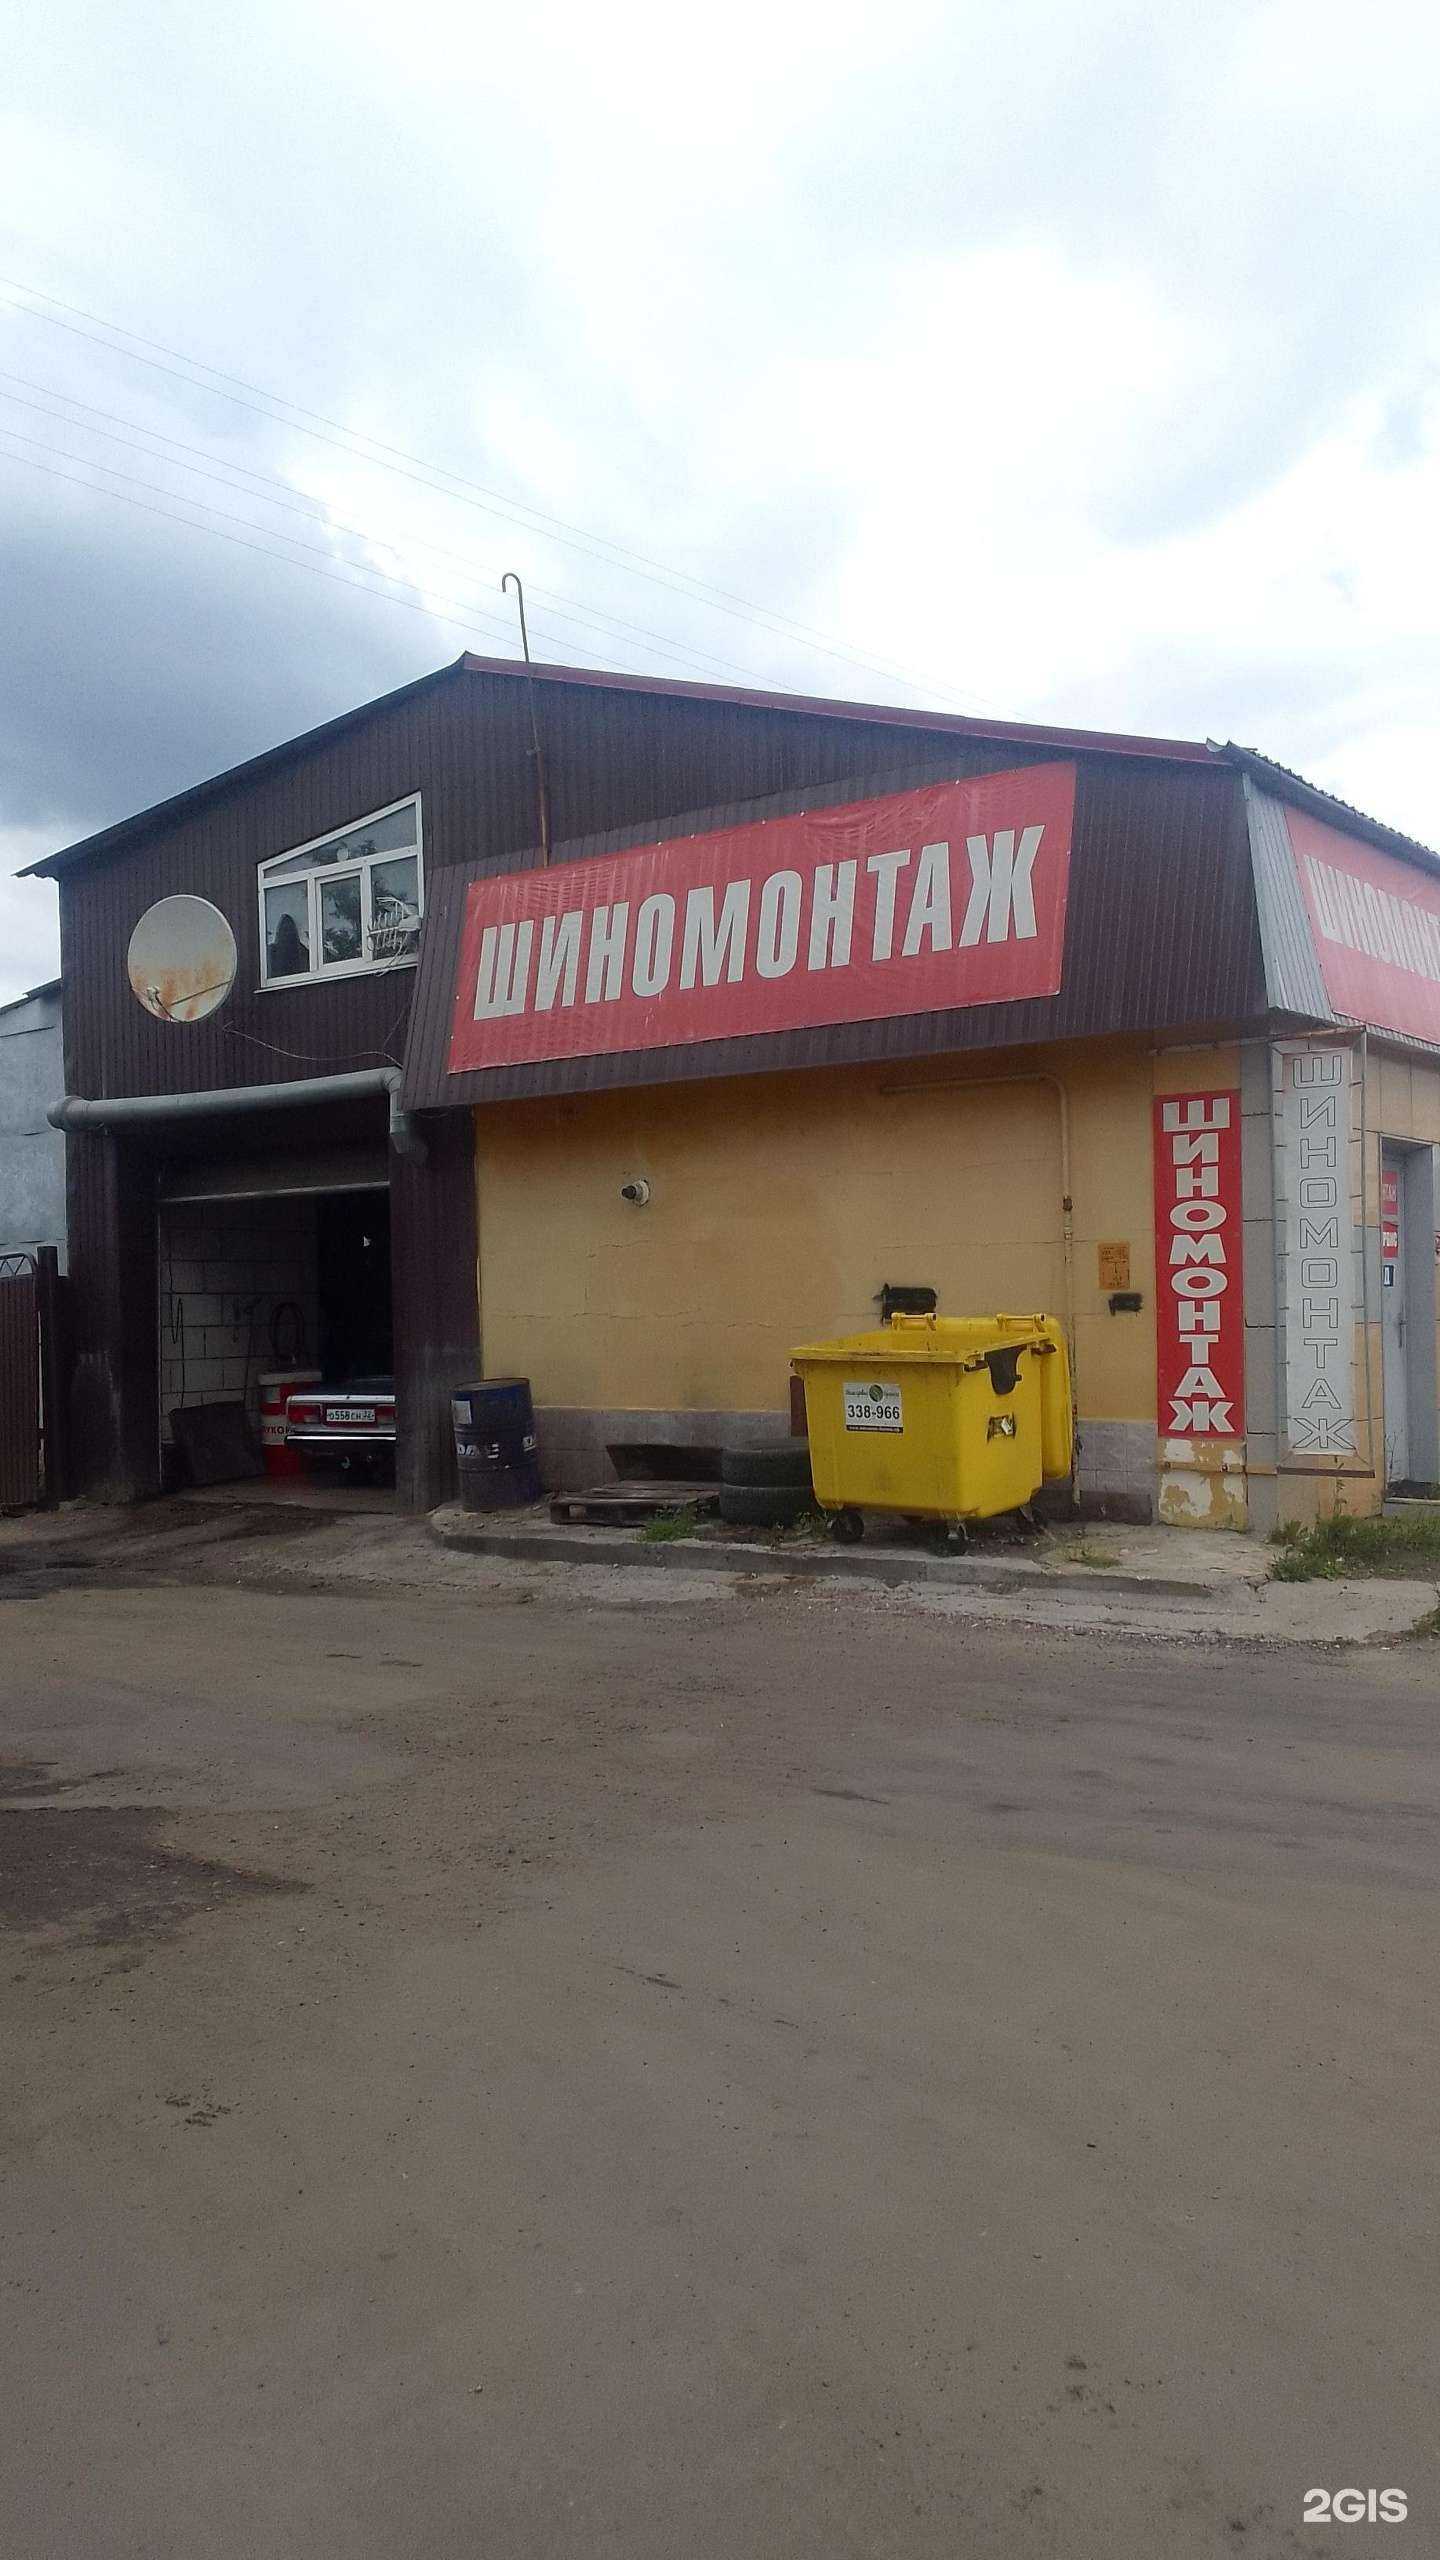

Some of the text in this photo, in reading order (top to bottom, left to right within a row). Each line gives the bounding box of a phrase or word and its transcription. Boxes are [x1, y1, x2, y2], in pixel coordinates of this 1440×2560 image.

[474, 825, 1045, 1020] ШИНОМОНТАЖ
[1162, 1097, 1234, 1434] ШИНОМОНТАЖ
[1293, 1054, 1356, 1450] ШИНОМОНТАЖ
[847, 1404, 900, 1420] 338-966
